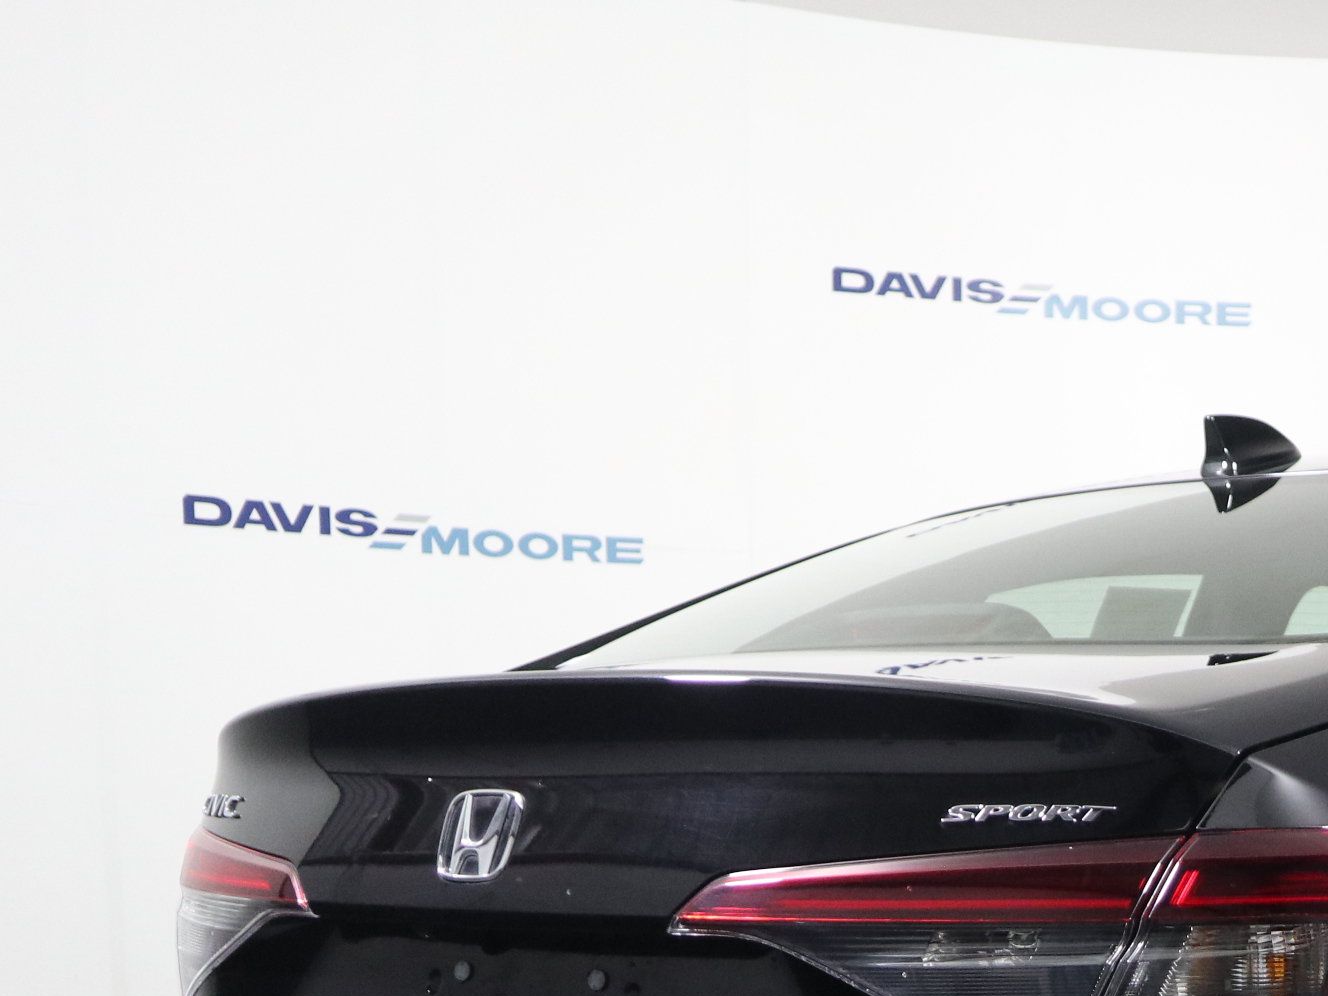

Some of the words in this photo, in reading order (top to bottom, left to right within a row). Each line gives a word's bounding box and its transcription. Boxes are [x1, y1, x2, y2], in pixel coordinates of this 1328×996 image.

[832, 266, 1005, 304] DAVIS
[1044, 294, 1252, 327] MOORE
[182, 493, 378, 538] DAVIS
[420, 525, 644, 565] MOORE
[940, 803, 1117, 823] SPORT
